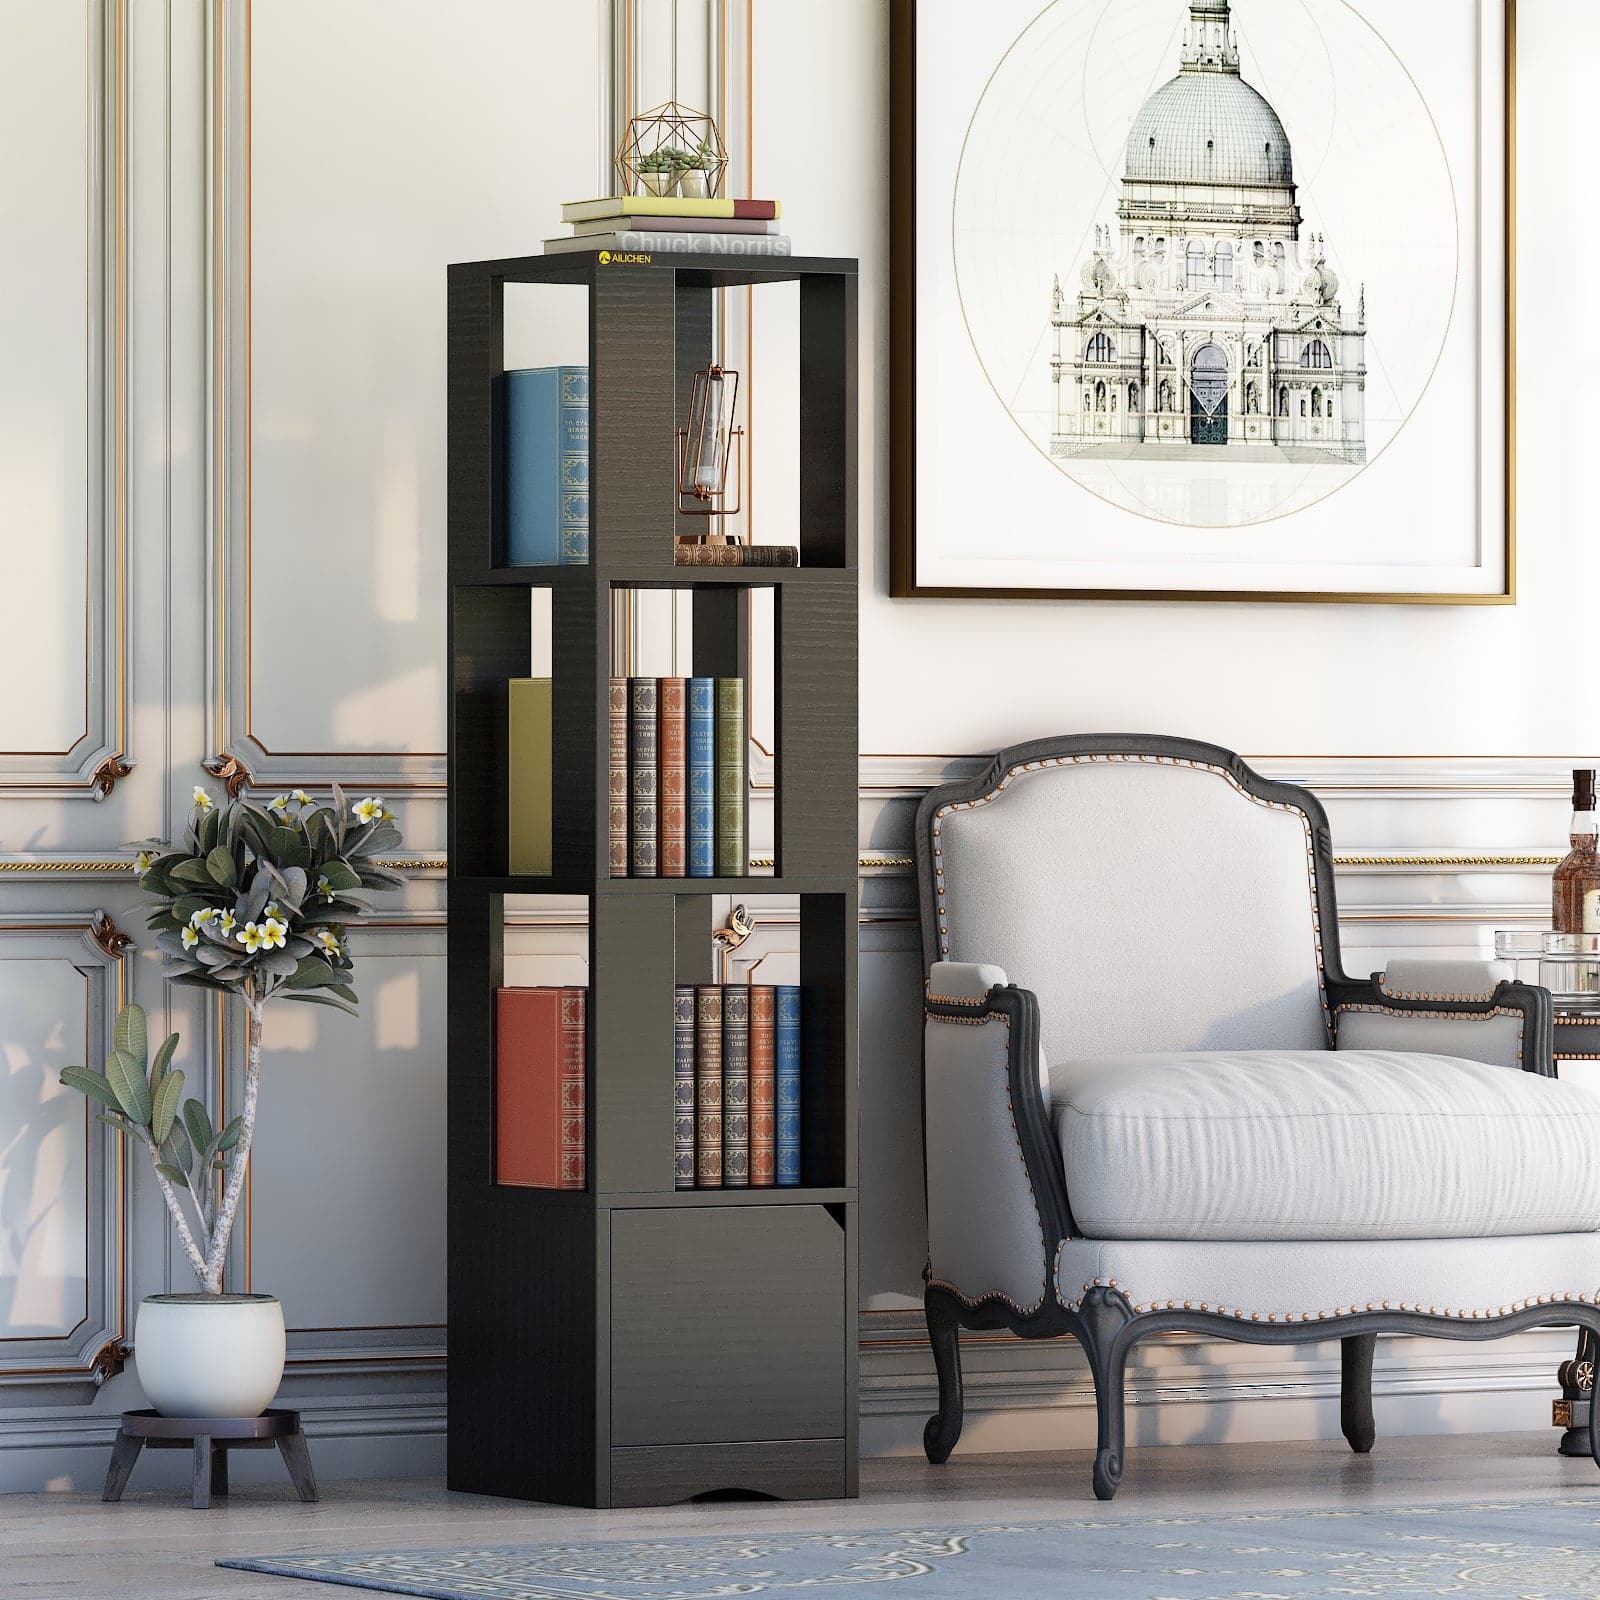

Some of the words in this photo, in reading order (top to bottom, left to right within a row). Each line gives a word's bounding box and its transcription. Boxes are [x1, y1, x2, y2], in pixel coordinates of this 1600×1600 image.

[621, 231, 699, 253] Chuck
[710, 235, 787, 256] Norris
[612, 253, 651, 263] AILICHEN
